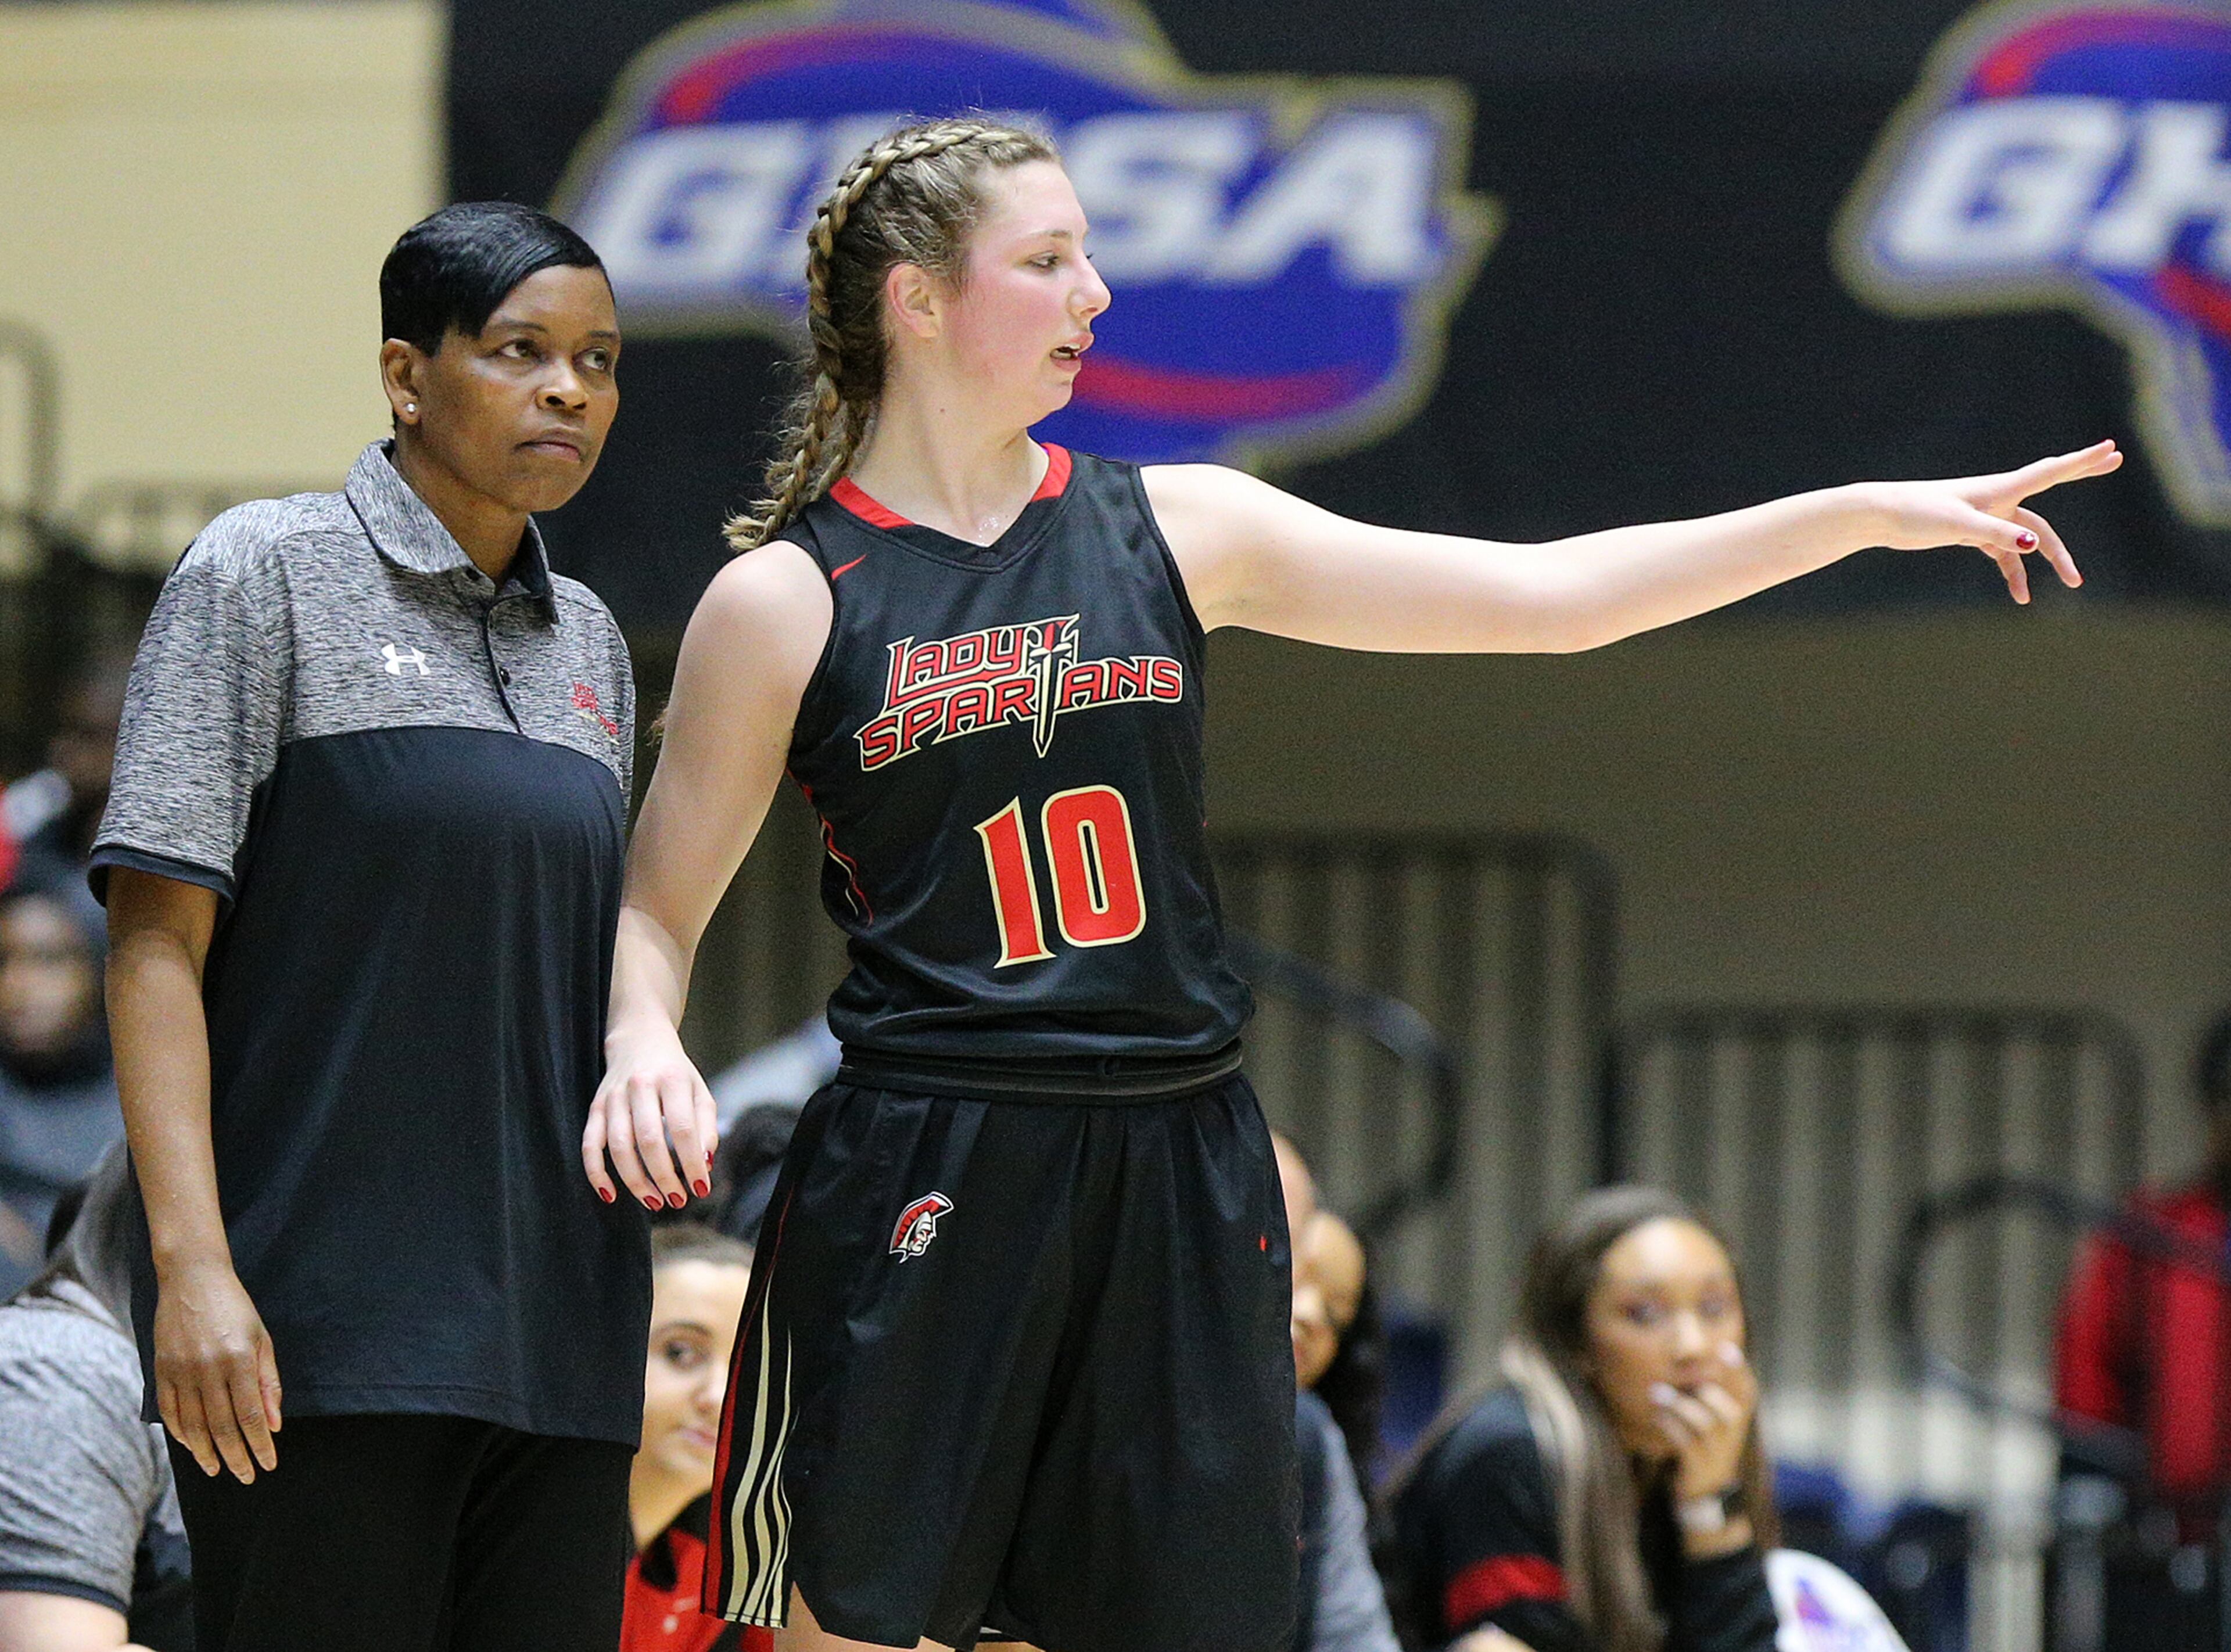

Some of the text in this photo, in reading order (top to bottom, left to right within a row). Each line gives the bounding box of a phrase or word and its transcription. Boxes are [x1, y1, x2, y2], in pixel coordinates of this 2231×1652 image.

[584, 113, 1440, 283] GSA
[853, 644, 1183, 771] SPARTANS
[887, 624, 1027, 711] LADY
[973, 784, 1147, 969] 10
